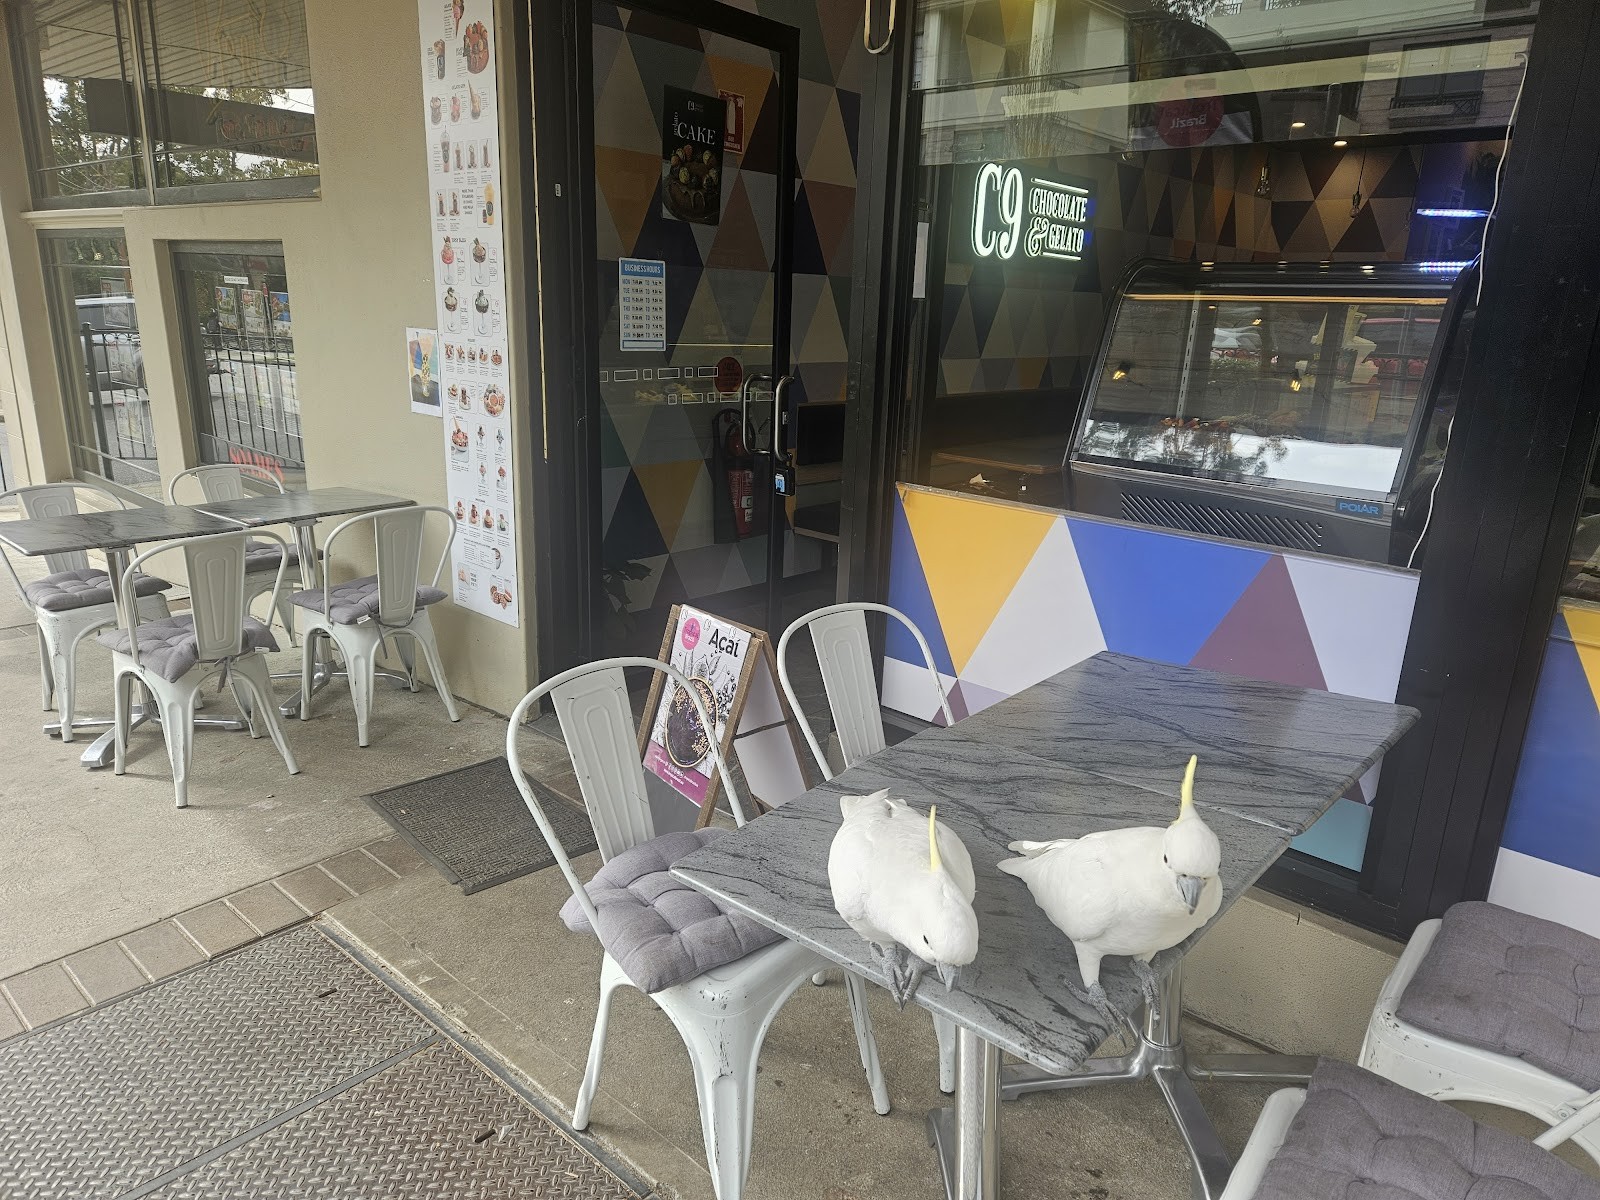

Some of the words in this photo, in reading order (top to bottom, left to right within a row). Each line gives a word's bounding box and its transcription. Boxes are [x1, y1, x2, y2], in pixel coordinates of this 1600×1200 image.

[677, 122, 716, 145] CAKE
[972, 163, 1024, 259] C9
[1030, 187, 1088, 222] CHOCOLATE
[1025, 216, 1050, 257] &
[1047, 224, 1085, 253] GELATO
[624, 263, 646, 273] BUSINESS
[647, 265, 661, 274] HOURS
[1339, 502, 1379, 515] POLAR
[708, 628, 741, 658] Açaí
